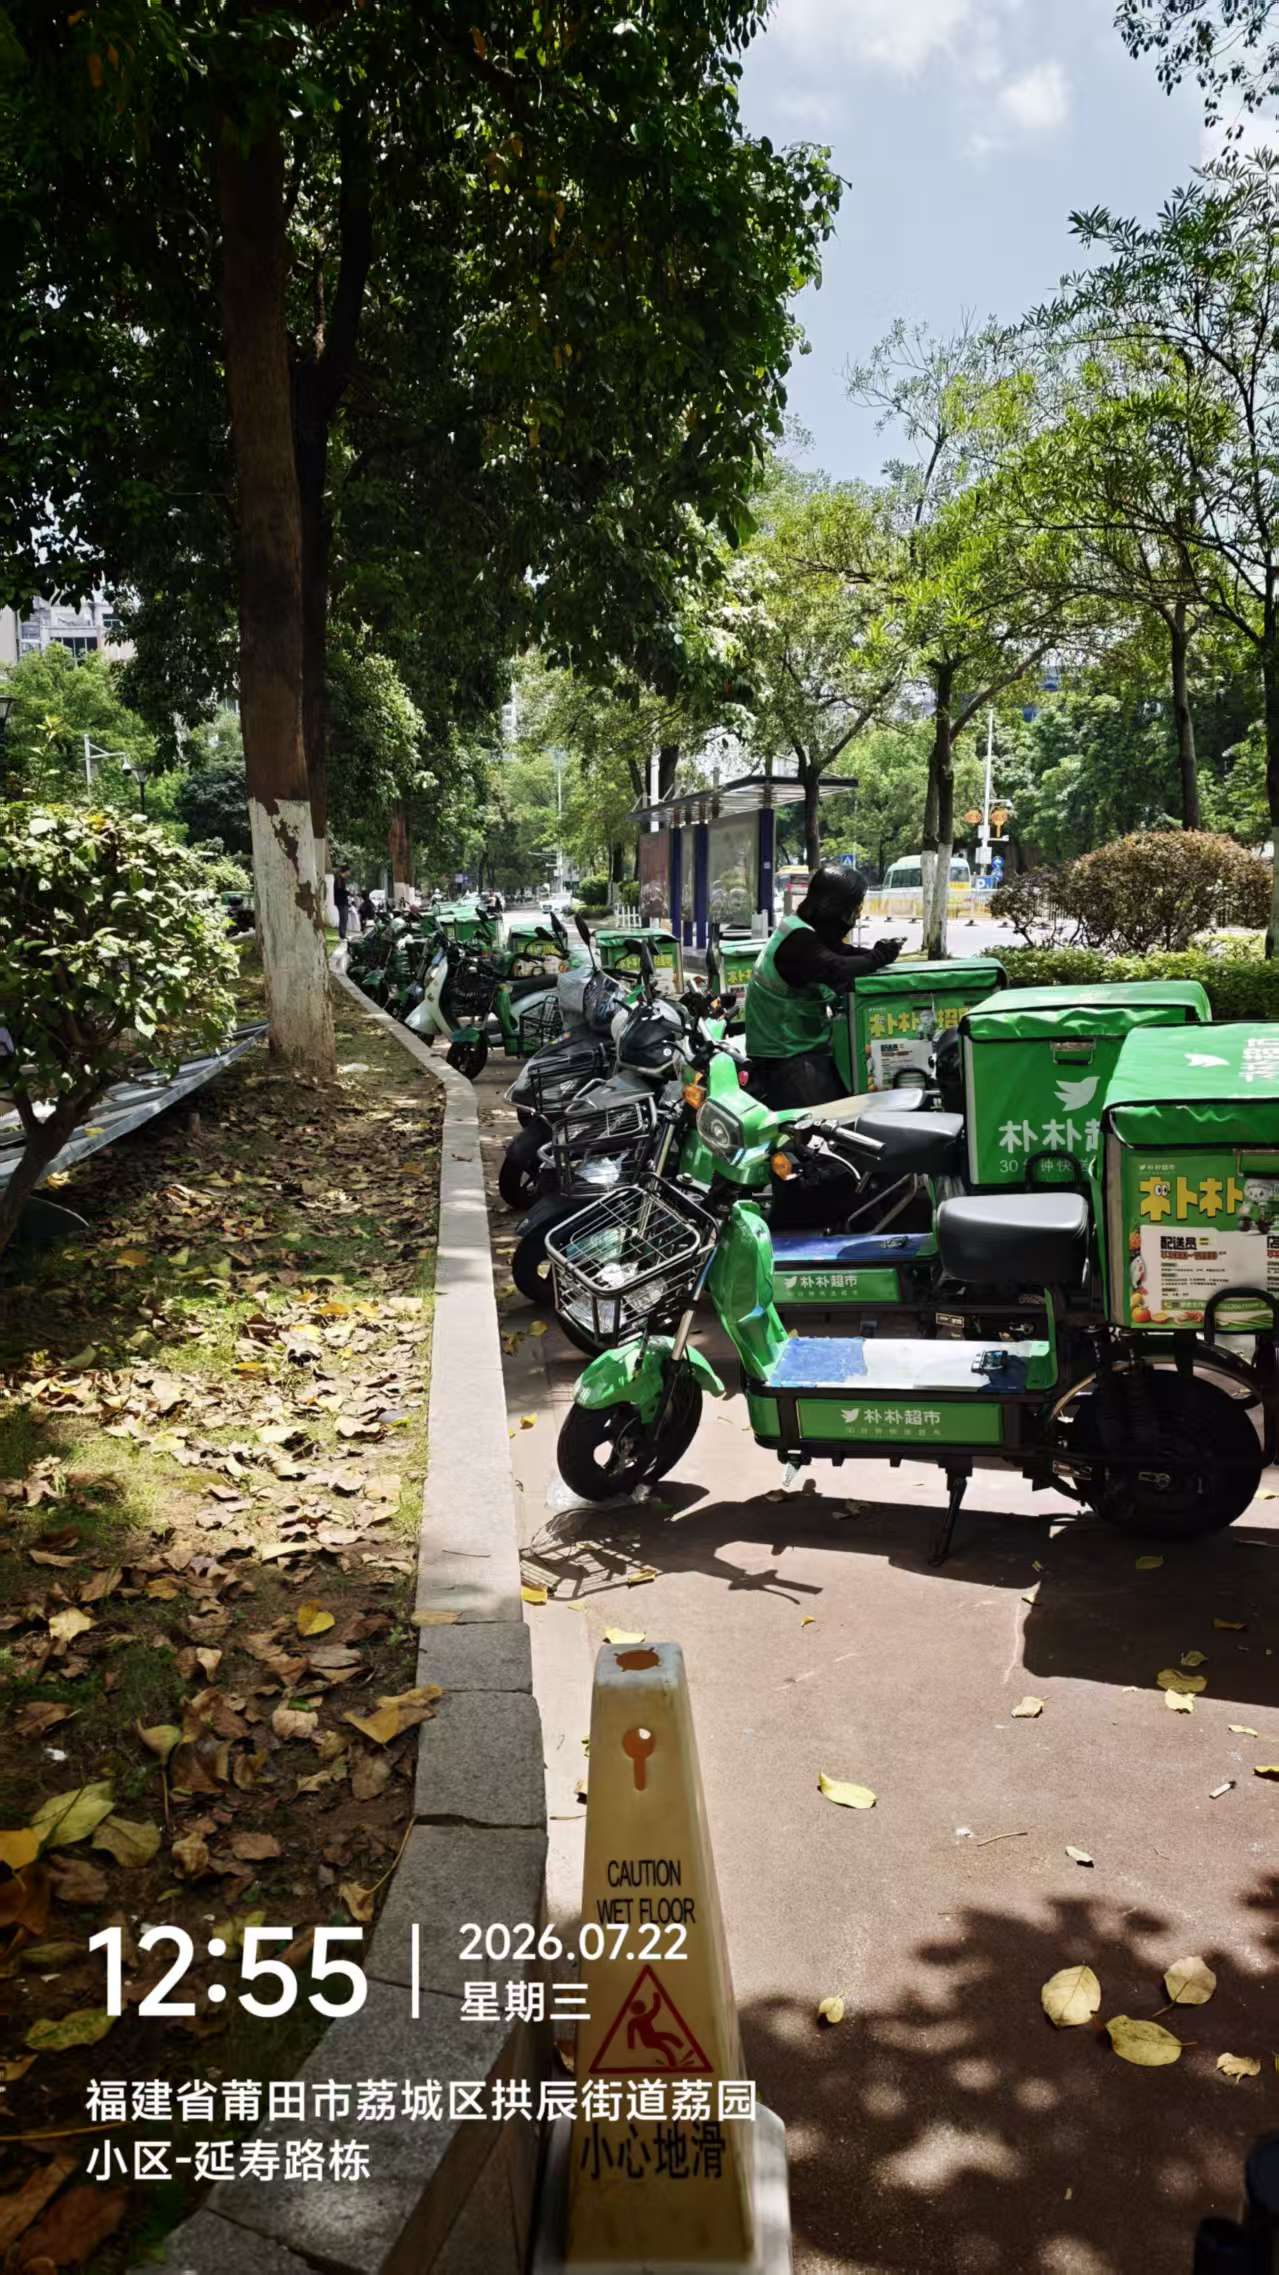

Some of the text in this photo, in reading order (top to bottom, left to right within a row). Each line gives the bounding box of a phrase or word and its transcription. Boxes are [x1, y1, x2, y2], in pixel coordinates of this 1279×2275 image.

[1160, 1235, 1197, 1250] 配送员
[800, 1274, 858, 1289] 朴朴超市
[864, 1408, 941, 1426] 朴朴超市
[607, 1859, 681, 1887] CAUTION
[597, 1897, 696, 1924] WET FLOOR
[580, 2121, 725, 2180] 小心地滑
